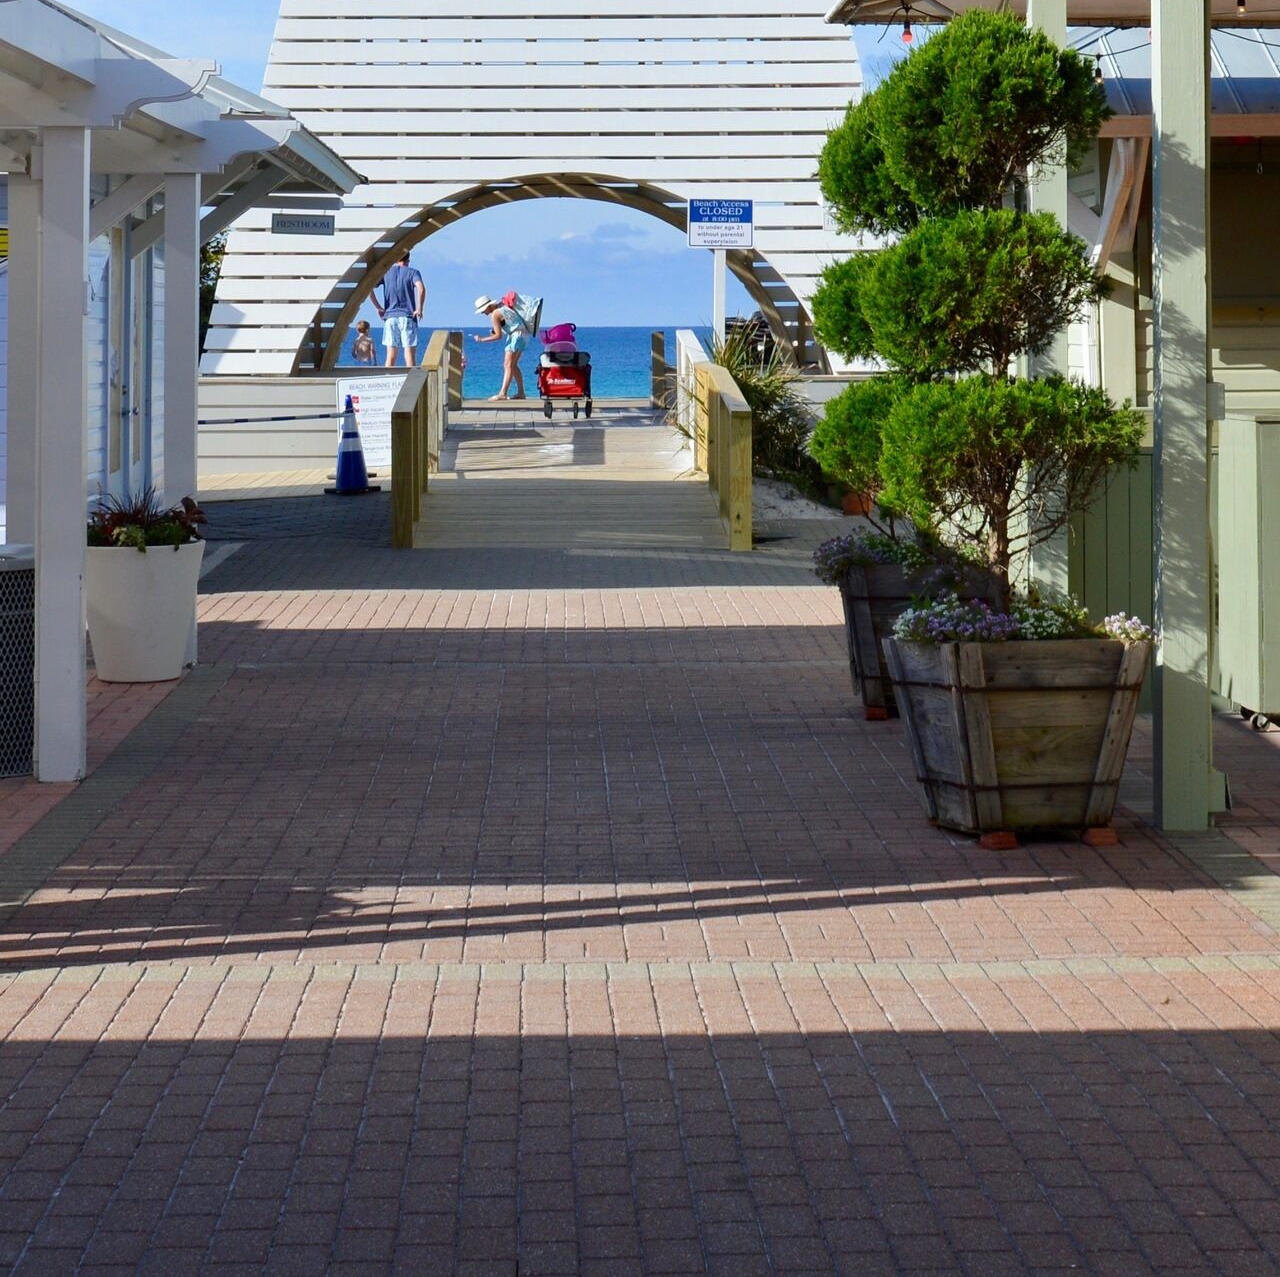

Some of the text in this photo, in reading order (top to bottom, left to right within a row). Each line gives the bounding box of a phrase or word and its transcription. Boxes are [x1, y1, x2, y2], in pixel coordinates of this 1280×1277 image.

[699, 207, 743, 215] CLOSED
[276, 219, 331, 229] RESTROOM
[368, 381, 390, 389] WARNING
